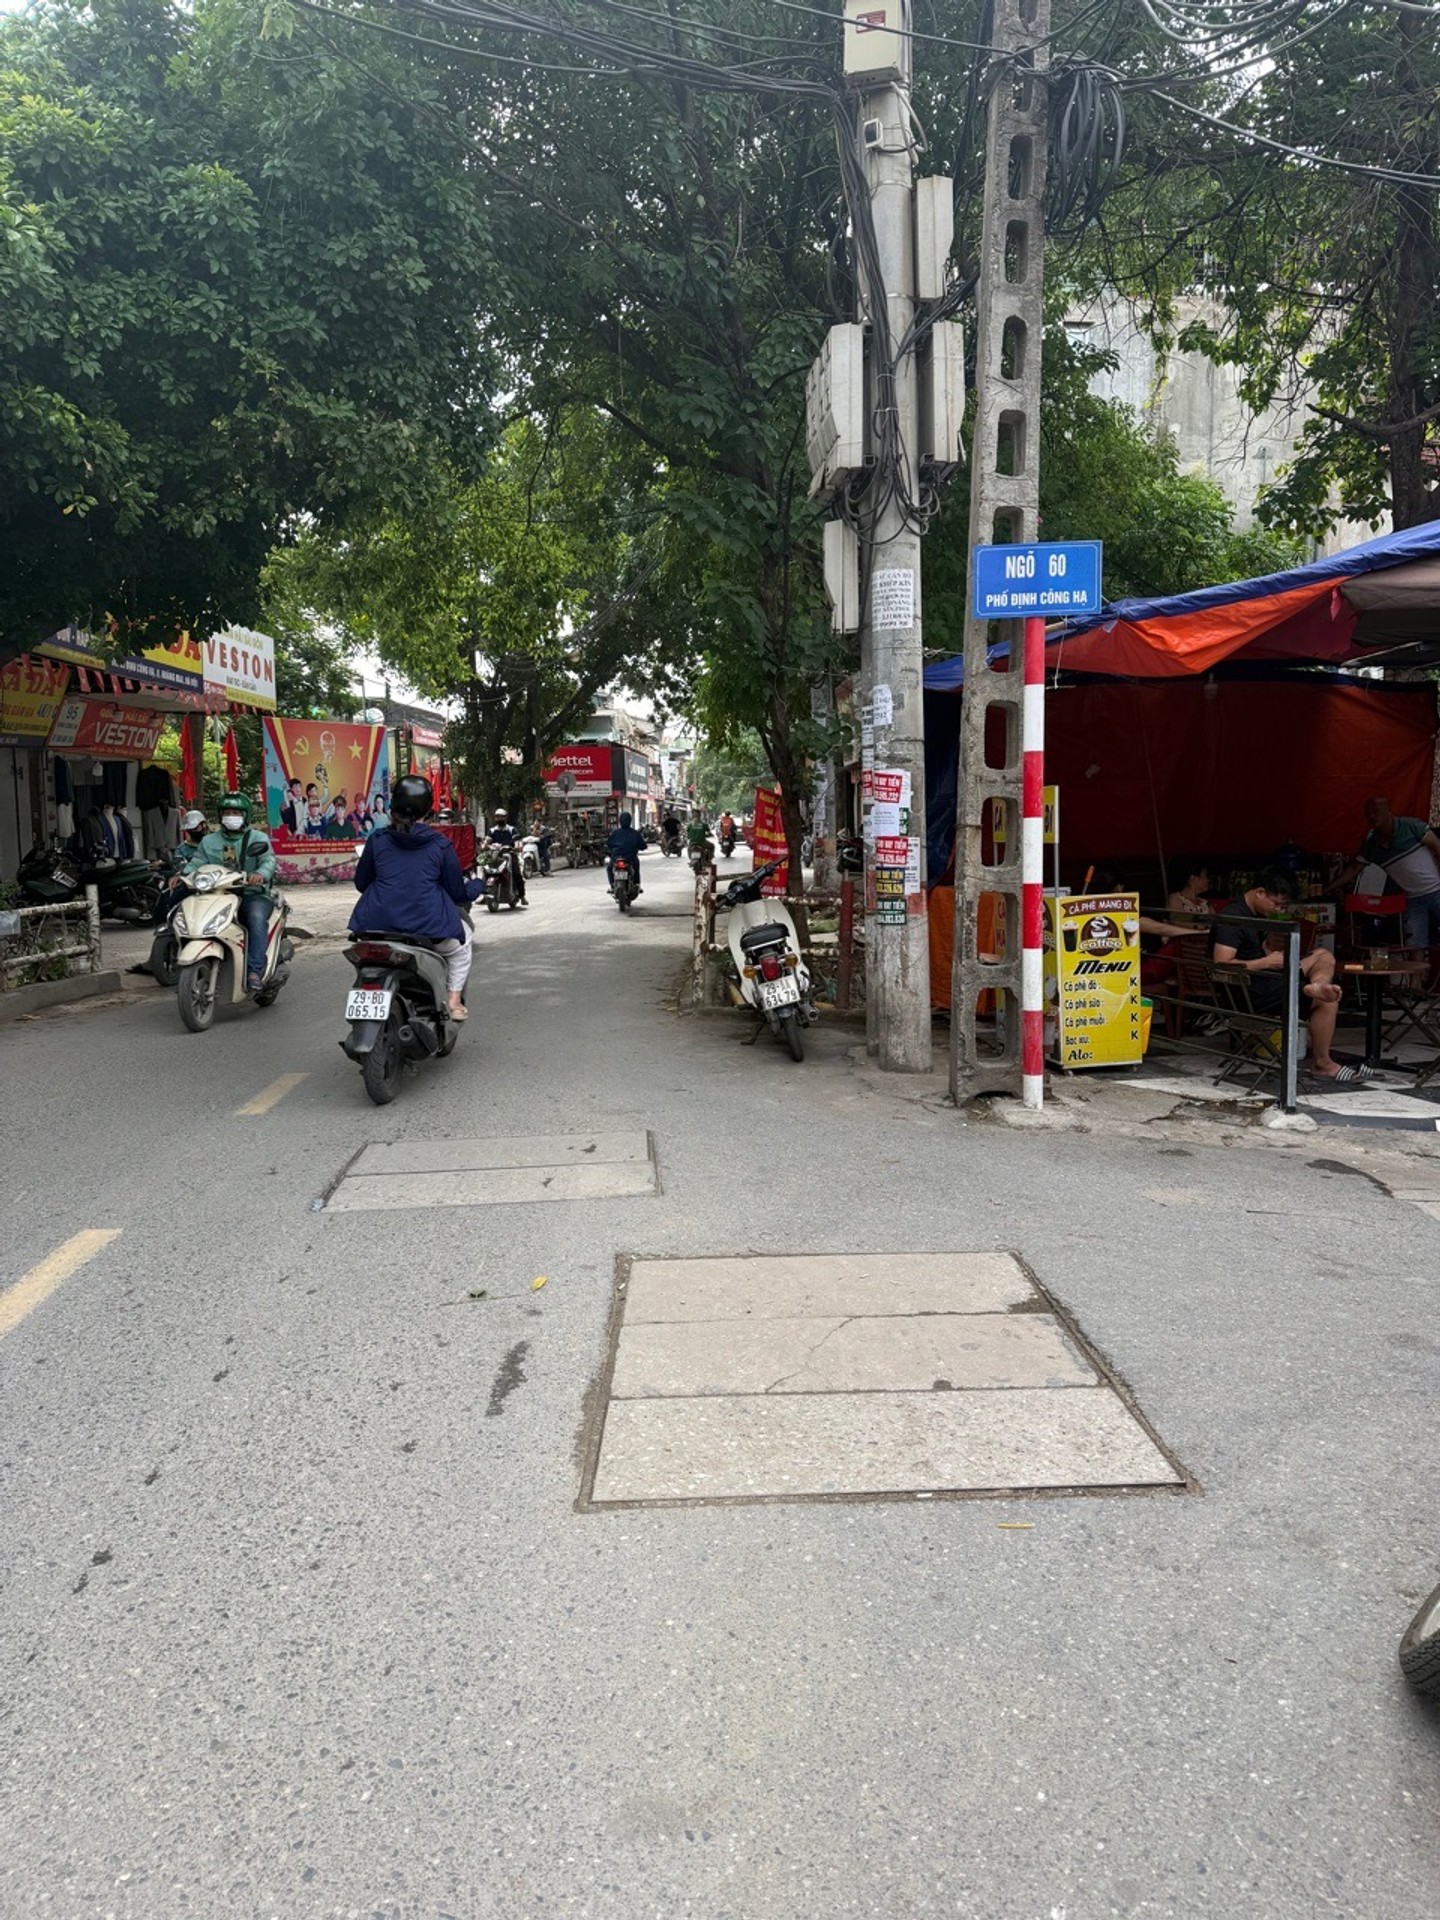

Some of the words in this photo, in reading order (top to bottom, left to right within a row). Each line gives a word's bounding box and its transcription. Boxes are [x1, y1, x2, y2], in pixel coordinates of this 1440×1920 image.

[1005, 550, 1035, 579] NGÕ
[1048, 553, 1067, 578] 60
[986, 588, 1009, 608] PHỐ
[1010, 592, 1037, 609] ĐỊNH
[1040, 588, 1070, 605] CÔNG
[1072, 590, 1088, 606] HẠ
[207, 638, 273, 683] VESTON
[94, 721, 159, 750] VESTON
[1069, 902, 1079, 914] CÀ
[1081, 900, 1096, 912] PHÊ
[1098, 899, 1122, 910] MANG
[1123, 900, 1132, 910] ĐI
[1064, 982, 1073, 992] Cà
[1074, 980, 1086, 991] phê
[1129, 977, 1138, 986] K
[1065, 1000, 1073, 1009] Cà
[1075, 998, 1087, 1010] phê
[1130, 995, 1138, 1004] K
[347, 1005, 386, 1018] 065.15
[1065, 1018, 1073, 1027] Cà
[1075, 1016, 1087, 1028] phê
[1131, 1013, 1138, 1022] K
[1131, 1030, 1138, 1040] K
[1068, 1049, 1093, 1061] Alo:
